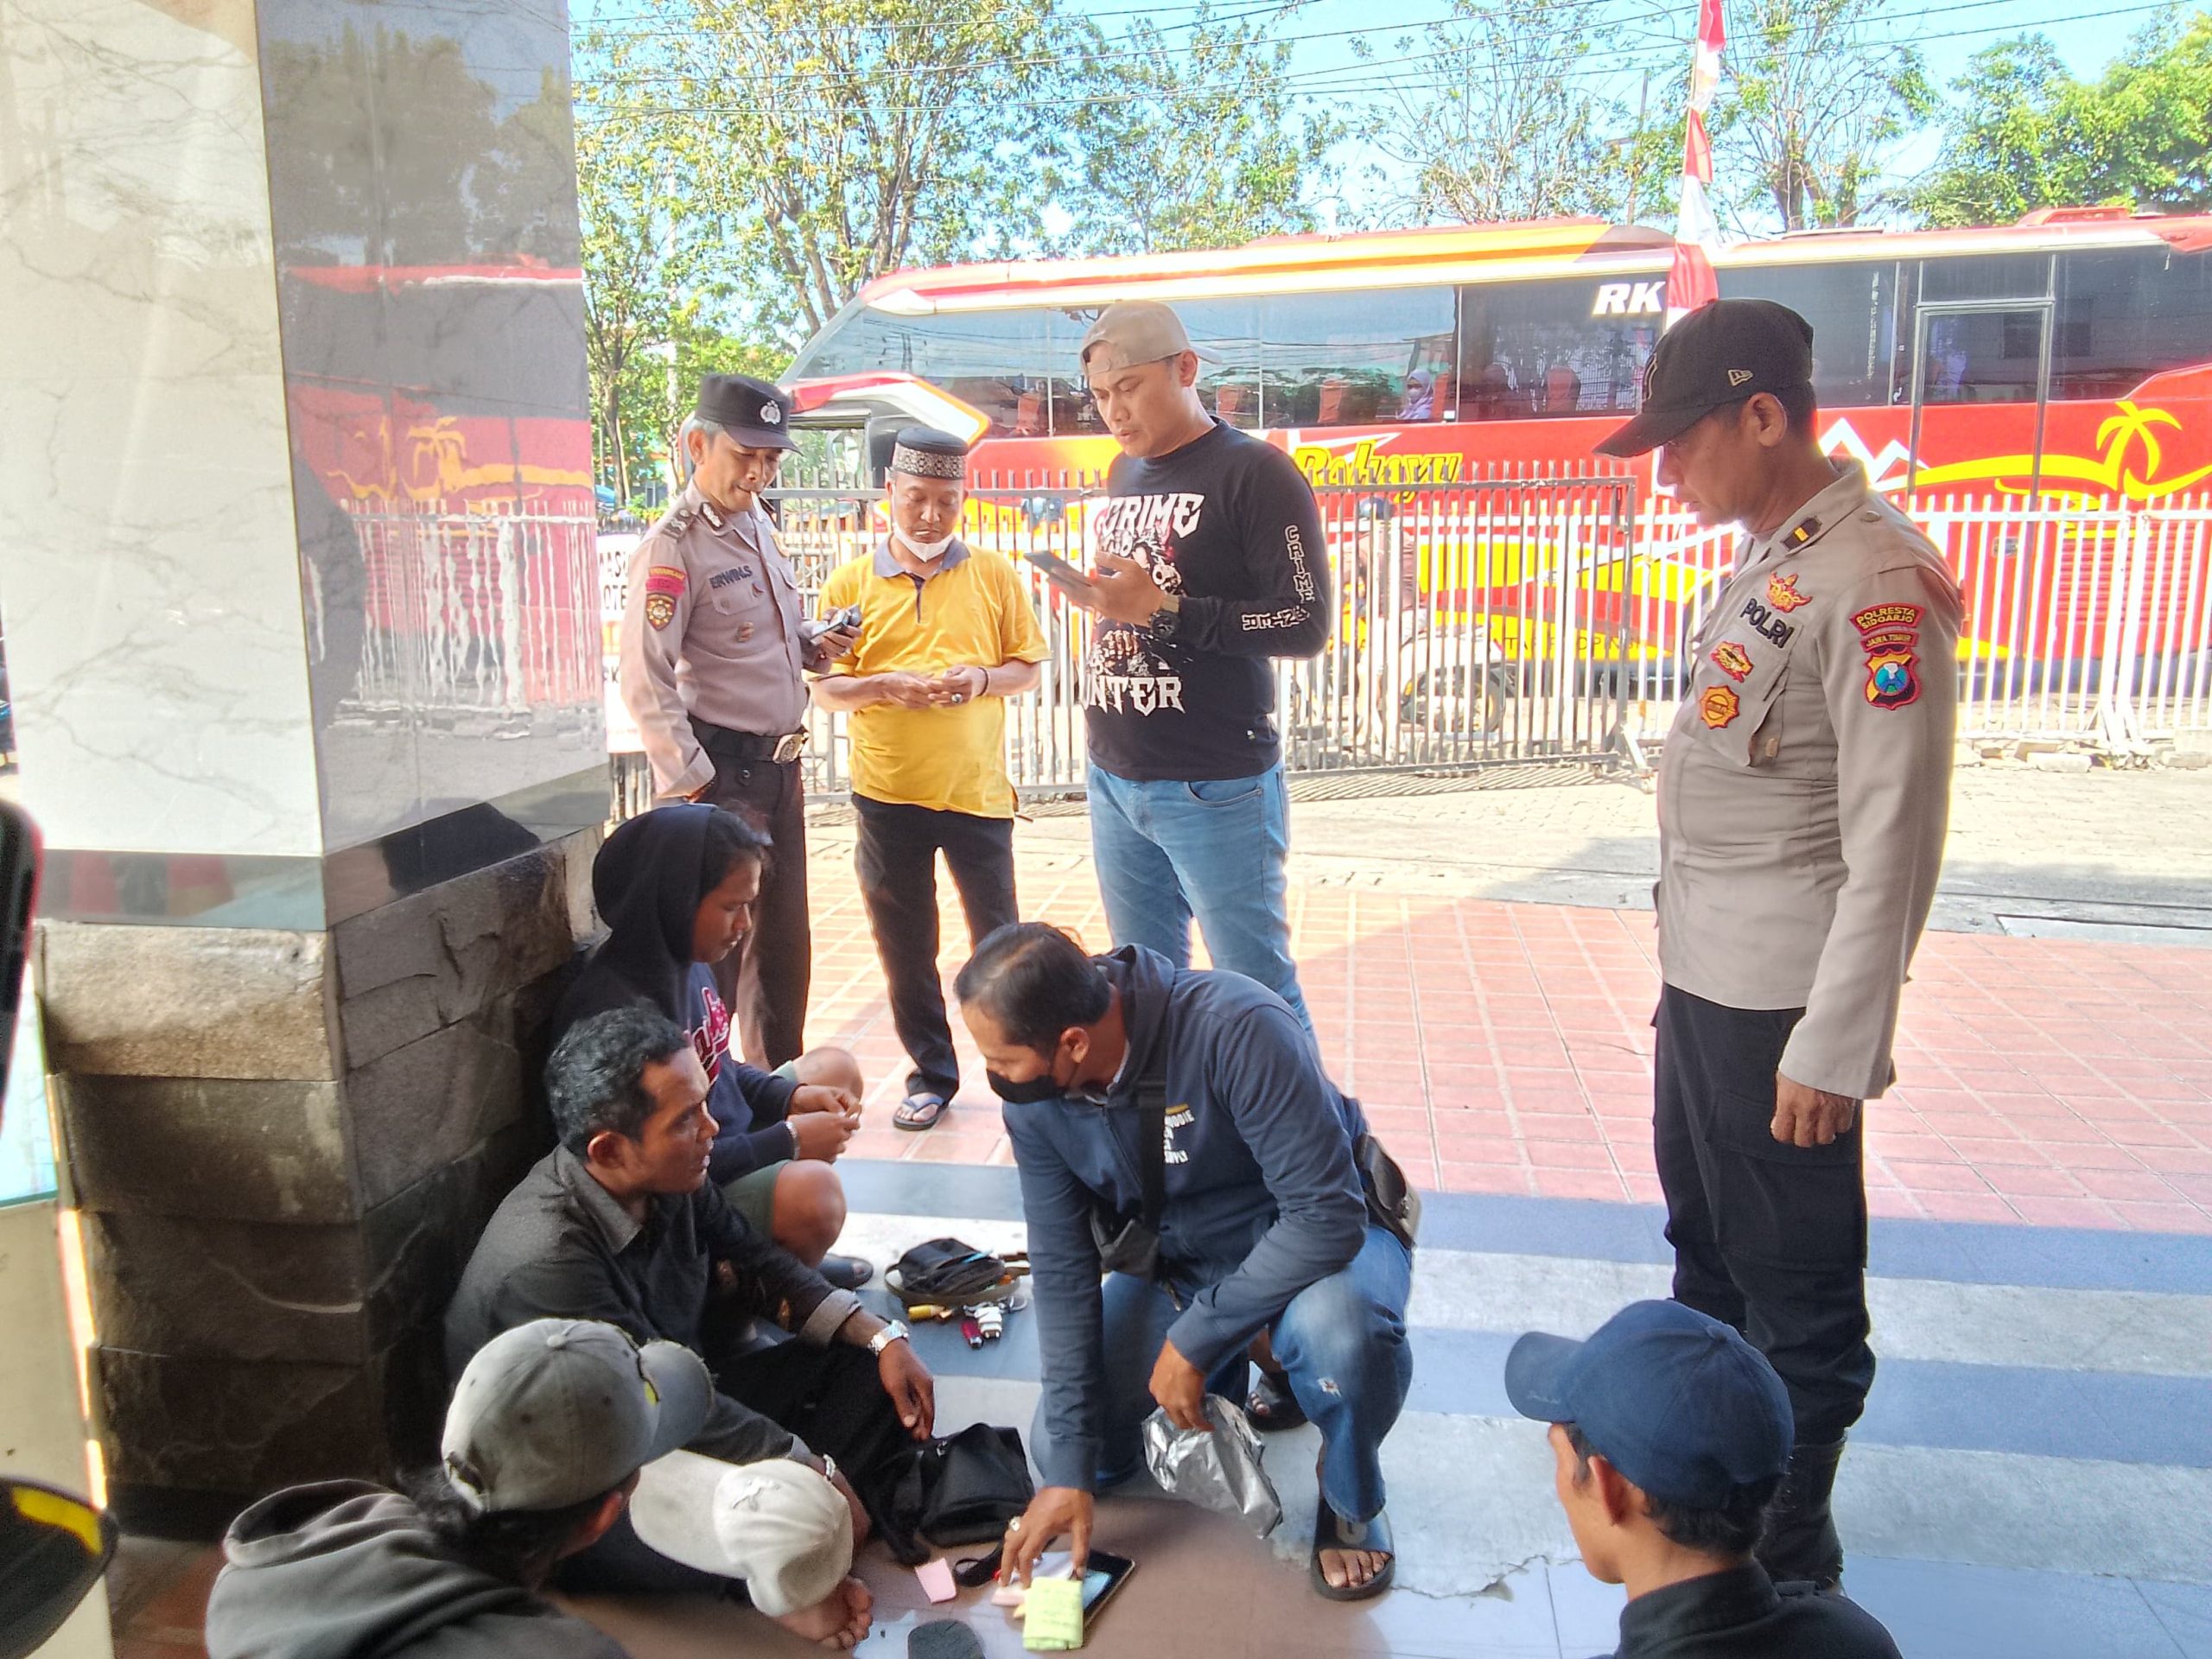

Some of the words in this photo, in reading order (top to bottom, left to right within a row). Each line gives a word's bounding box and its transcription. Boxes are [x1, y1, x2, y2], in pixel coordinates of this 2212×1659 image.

[1592, 281, 1666, 315] RK
[1096, 493, 1205, 542] CRIME
[1284, 524, 1315, 604] CRIME
[1739, 598, 1795, 649] POLRI
[1856, 607, 1916, 626] POLRESTA
